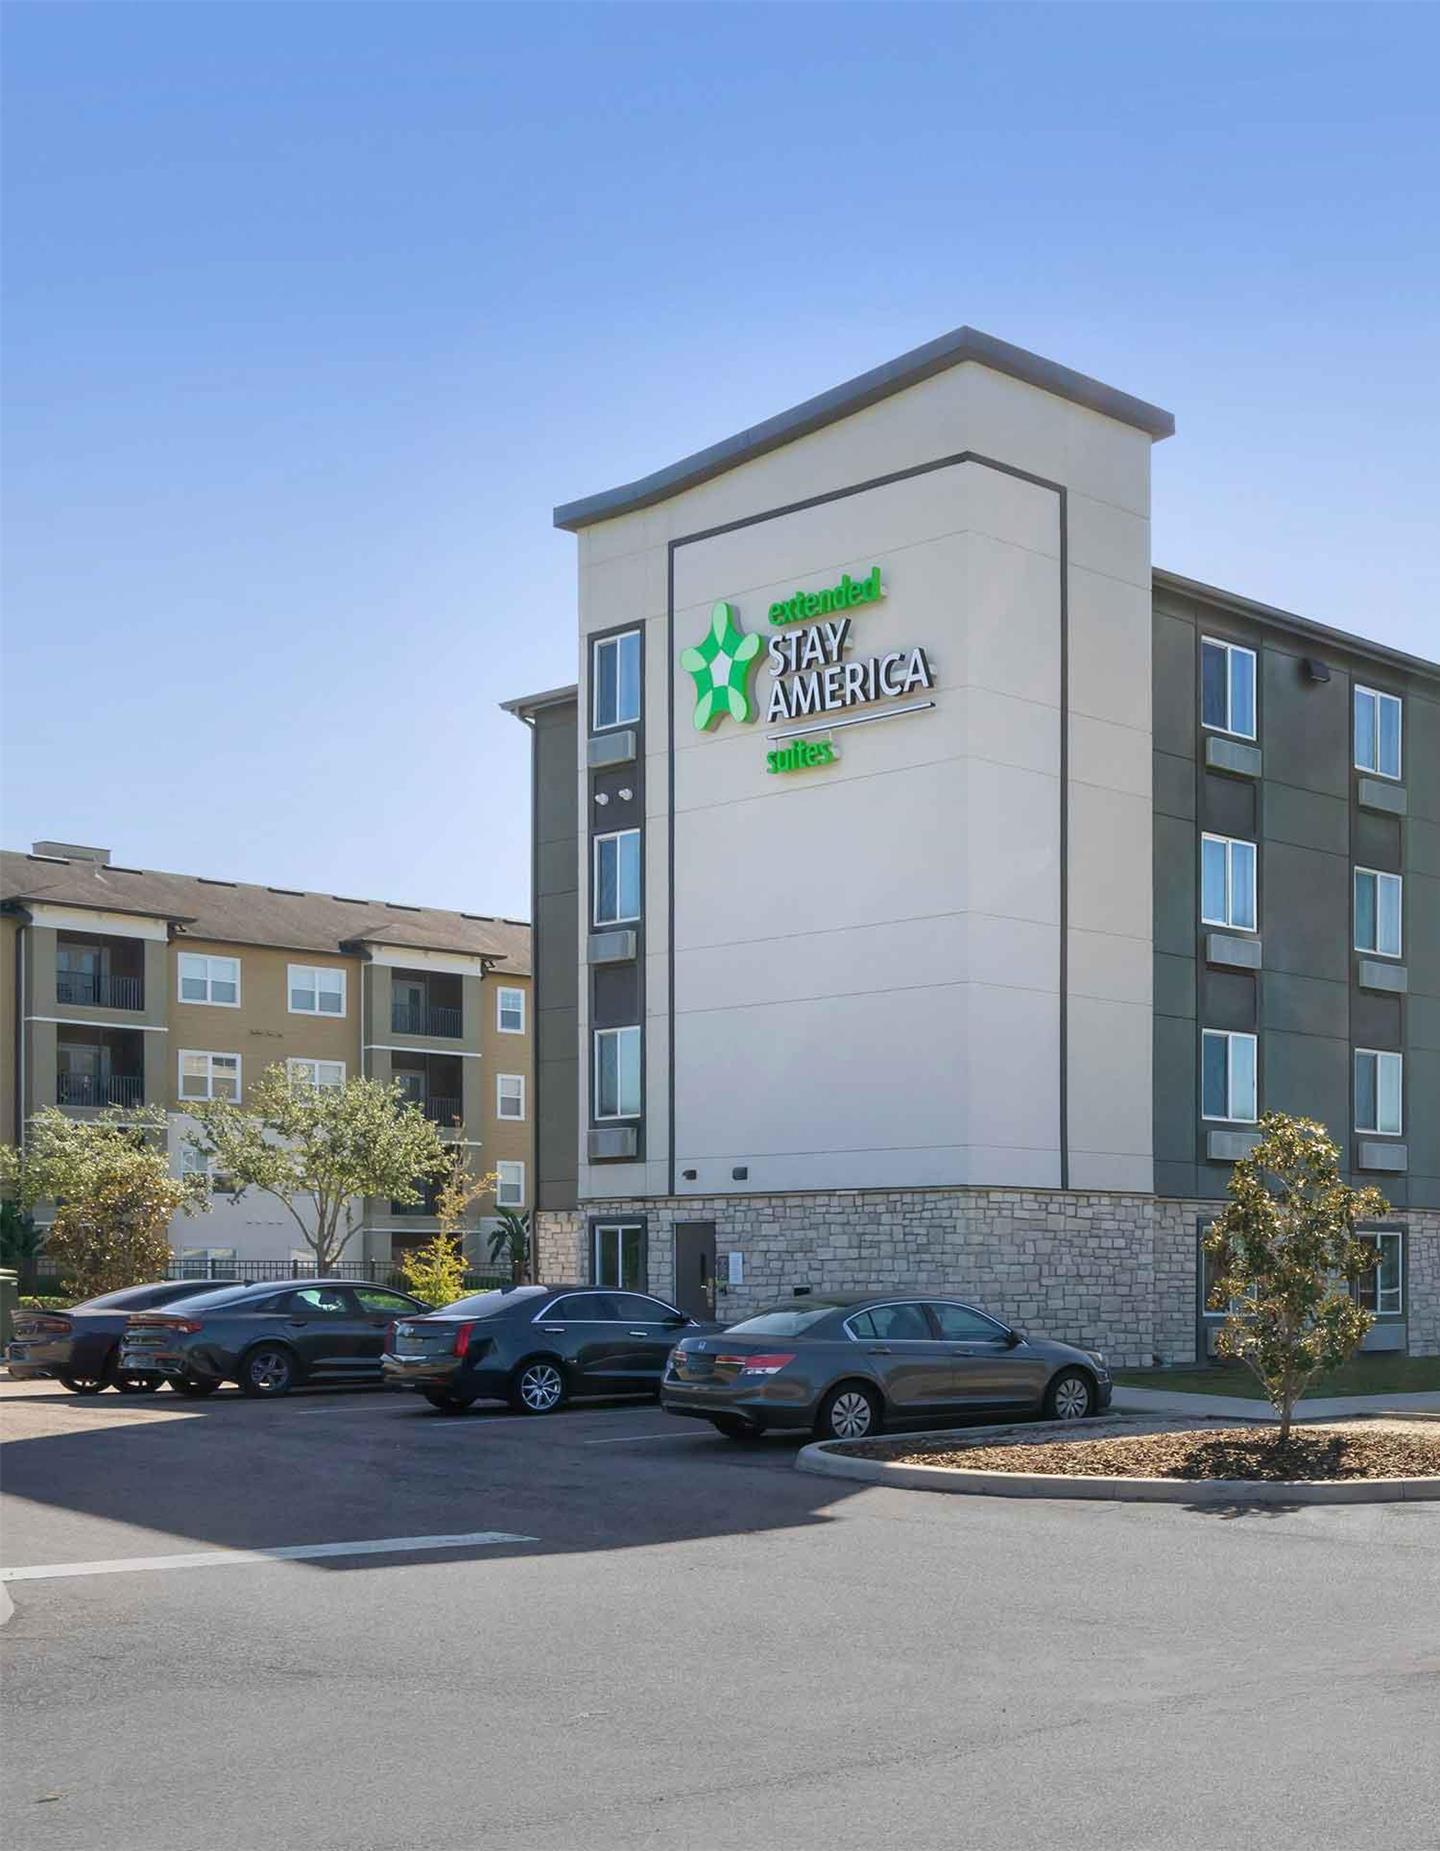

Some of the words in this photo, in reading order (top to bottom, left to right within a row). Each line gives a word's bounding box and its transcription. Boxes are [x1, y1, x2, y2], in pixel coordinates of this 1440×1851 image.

[768, 566, 881, 625] extended
[768, 618, 851, 677] STAY
[767, 647, 934, 722] AMERICA
[767, 740, 834, 773] suites
